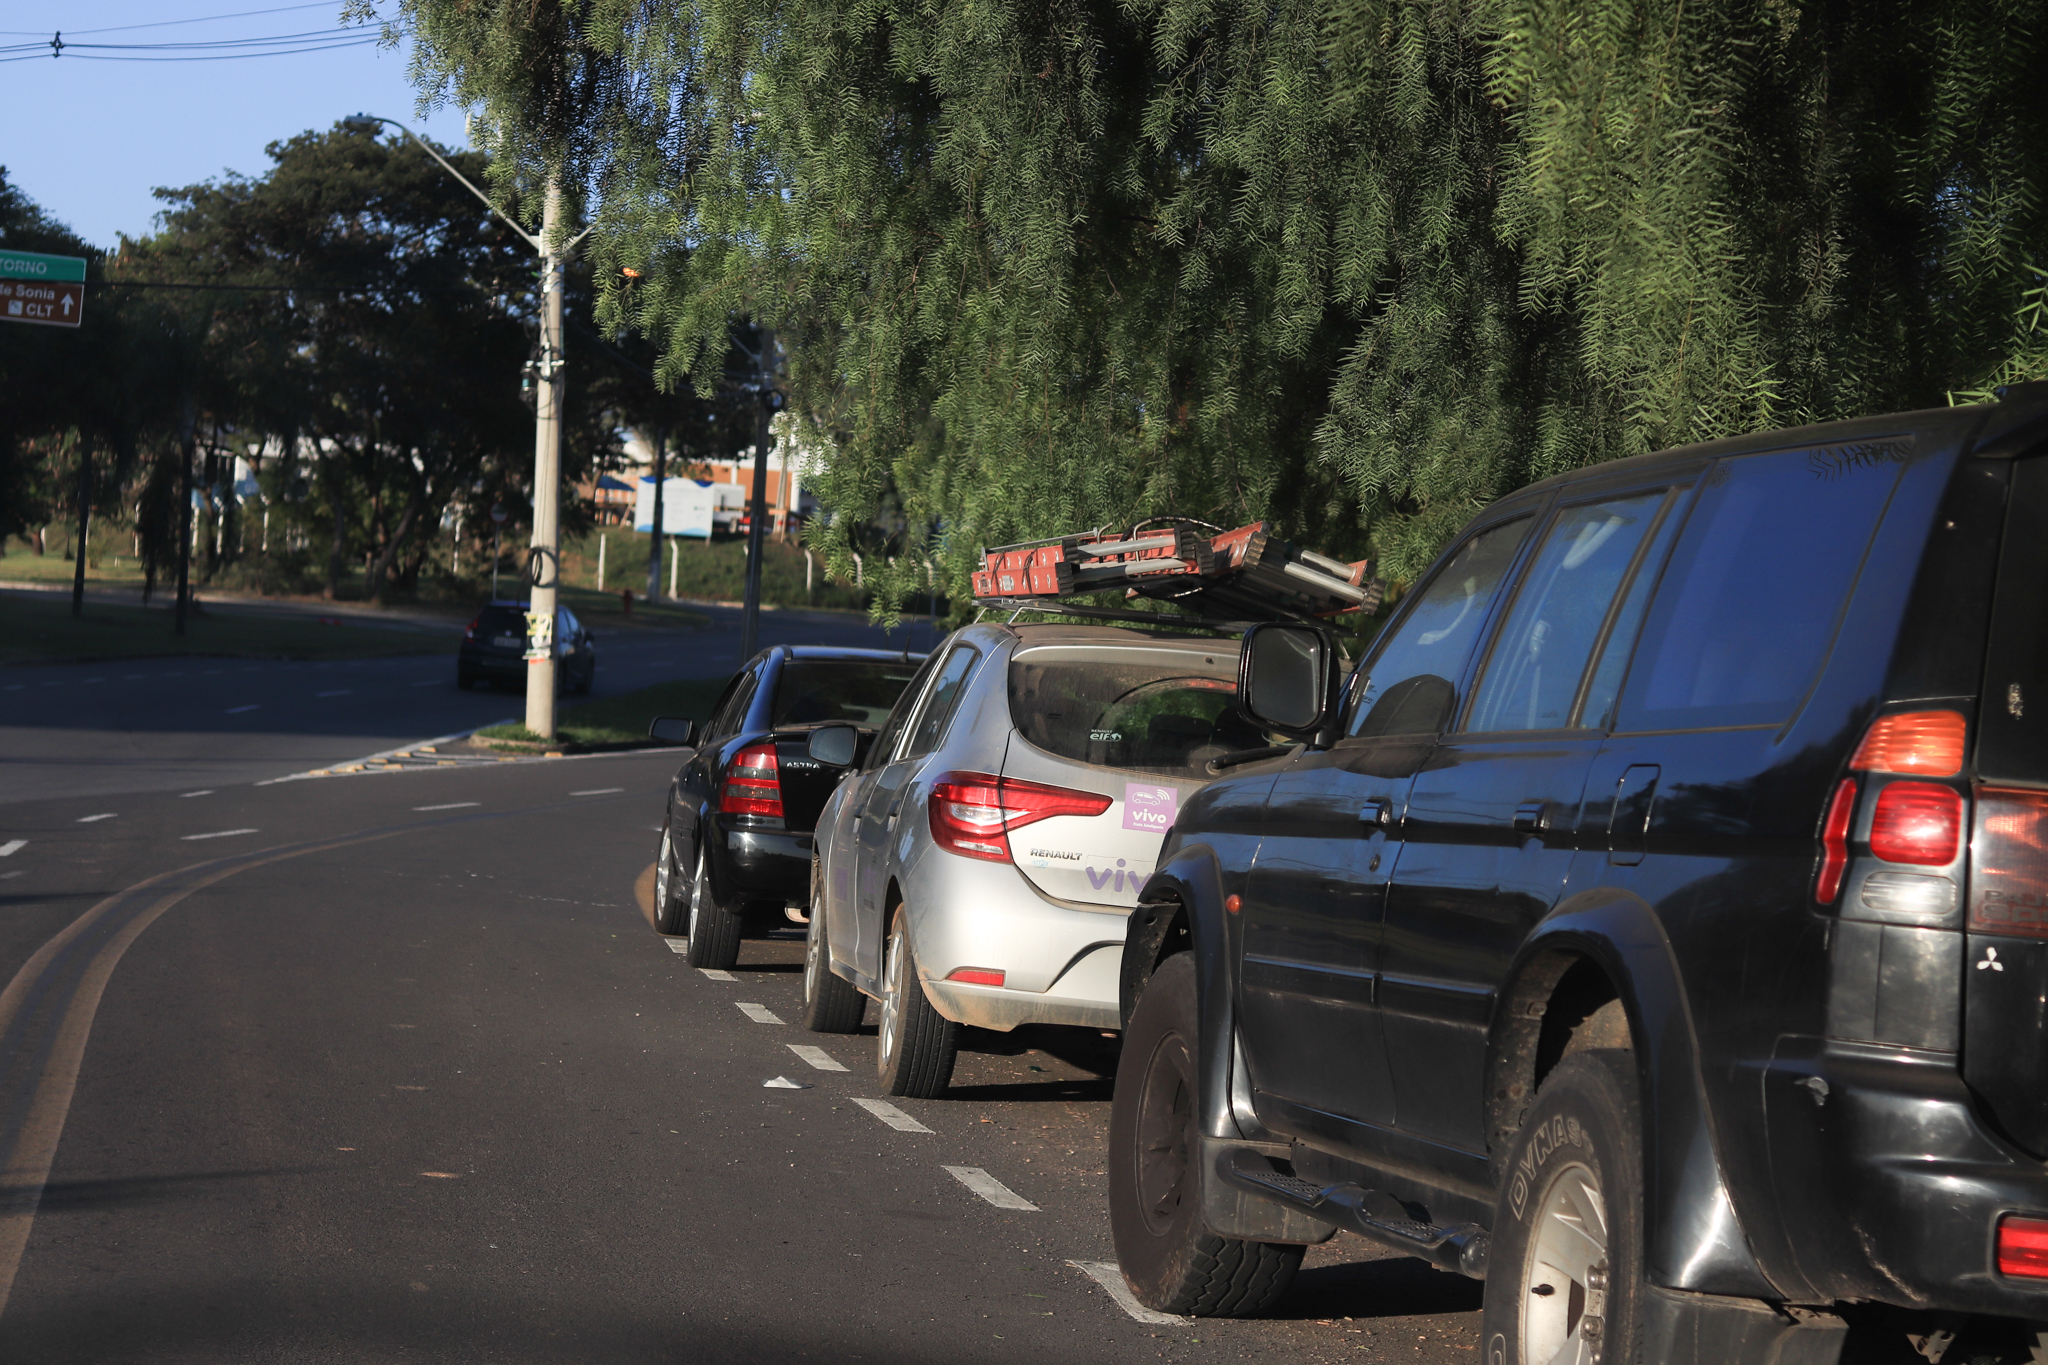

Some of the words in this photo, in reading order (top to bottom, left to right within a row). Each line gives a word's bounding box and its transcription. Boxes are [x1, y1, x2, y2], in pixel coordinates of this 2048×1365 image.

[16, 284, 55, 300] Sonia
[26, 302, 54, 318] CLT
[786, 761, 820, 769] ASTRA
[1132, 808, 1167, 824] vivo
[1030, 848, 1083, 861] RENAULT
[1984, 890, 2048, 907] PAJ
[1983, 903, 2048, 923] SP
